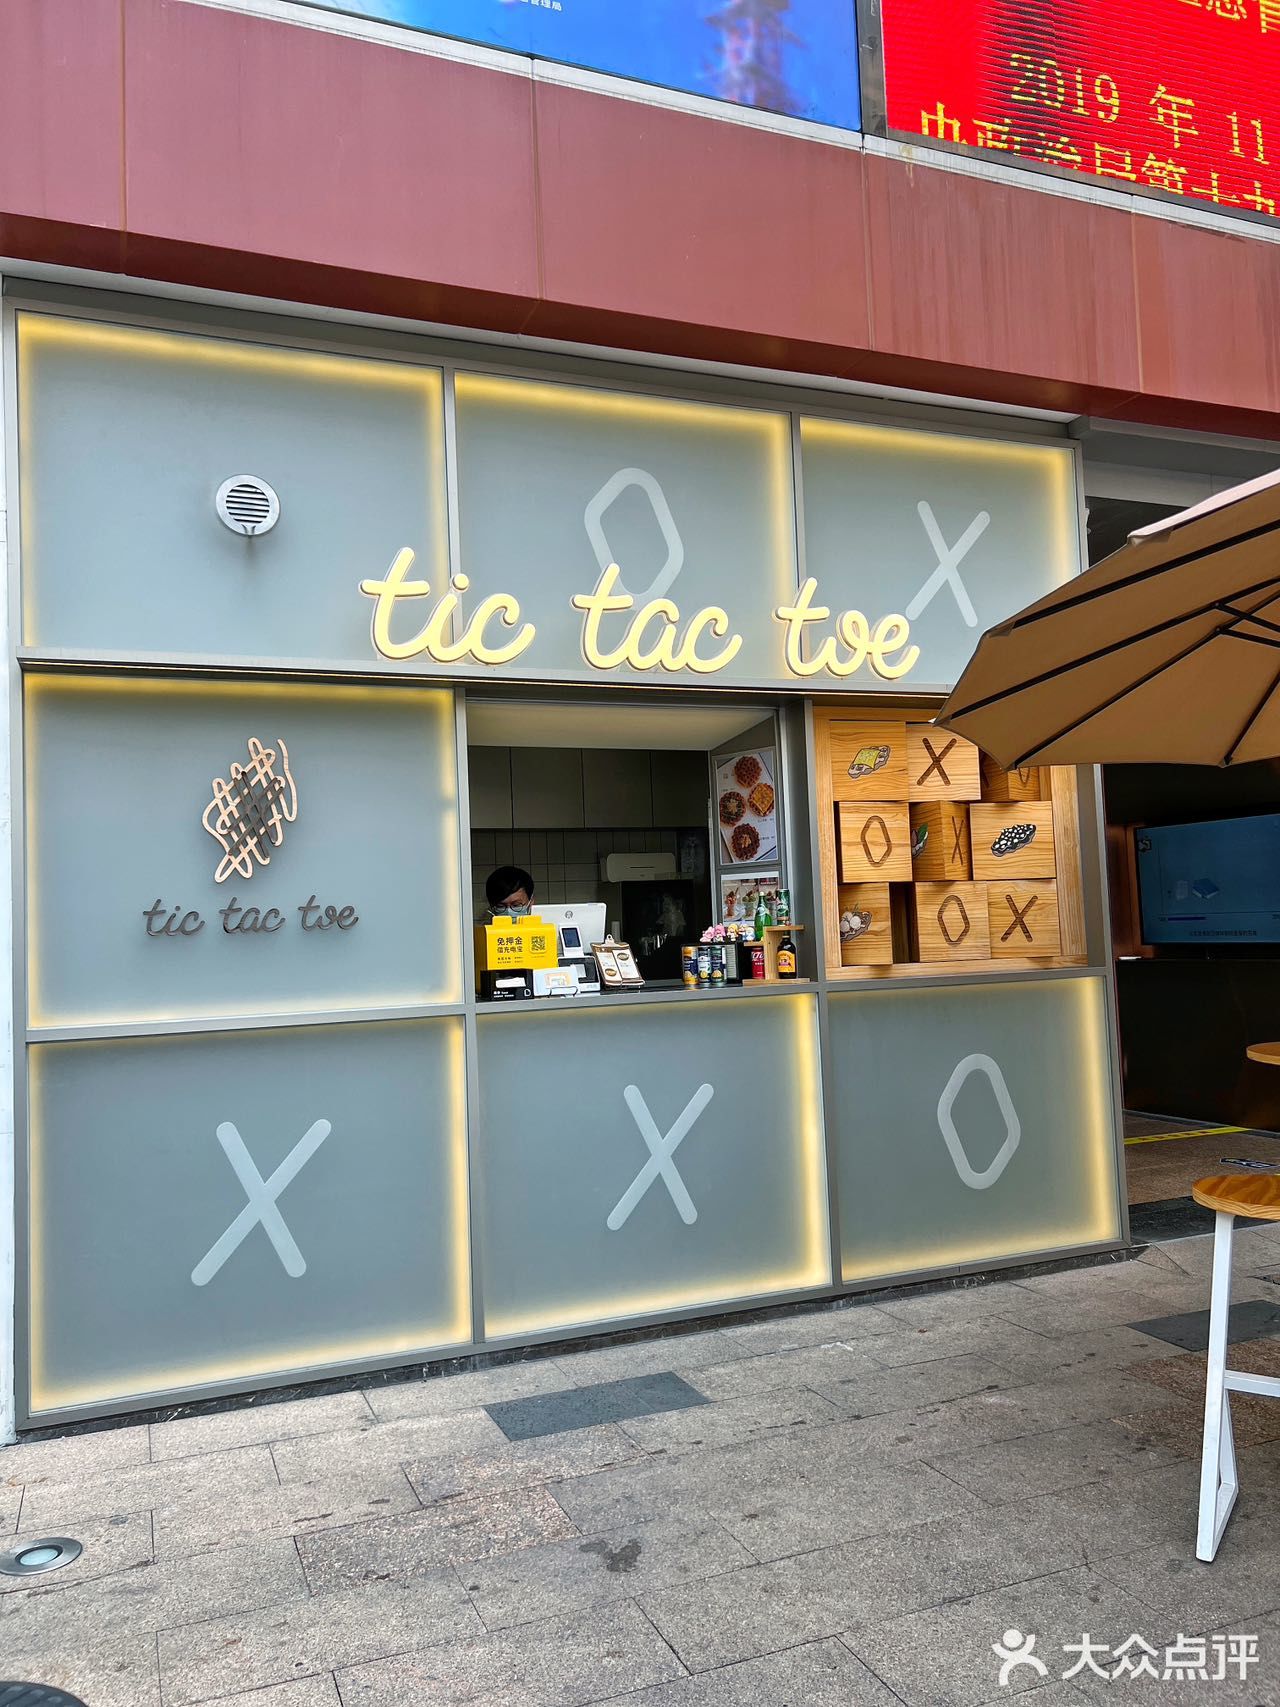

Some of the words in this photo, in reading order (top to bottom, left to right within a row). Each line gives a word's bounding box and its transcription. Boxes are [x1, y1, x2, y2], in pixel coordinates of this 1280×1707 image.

[1010, 53, 1120, 123] 2019
[1149, 83, 1199, 149] 年
[1226, 112, 1270, 165] 11
[360, 546, 537, 665] tic
[570, 563, 743, 673] tac
[775, 576, 921, 680] toe
[143, 899, 205, 936] tic
[219, 897, 286, 934] tac
[298, 894, 358, 931] toe
[497, 936, 522, 946] 免押金
